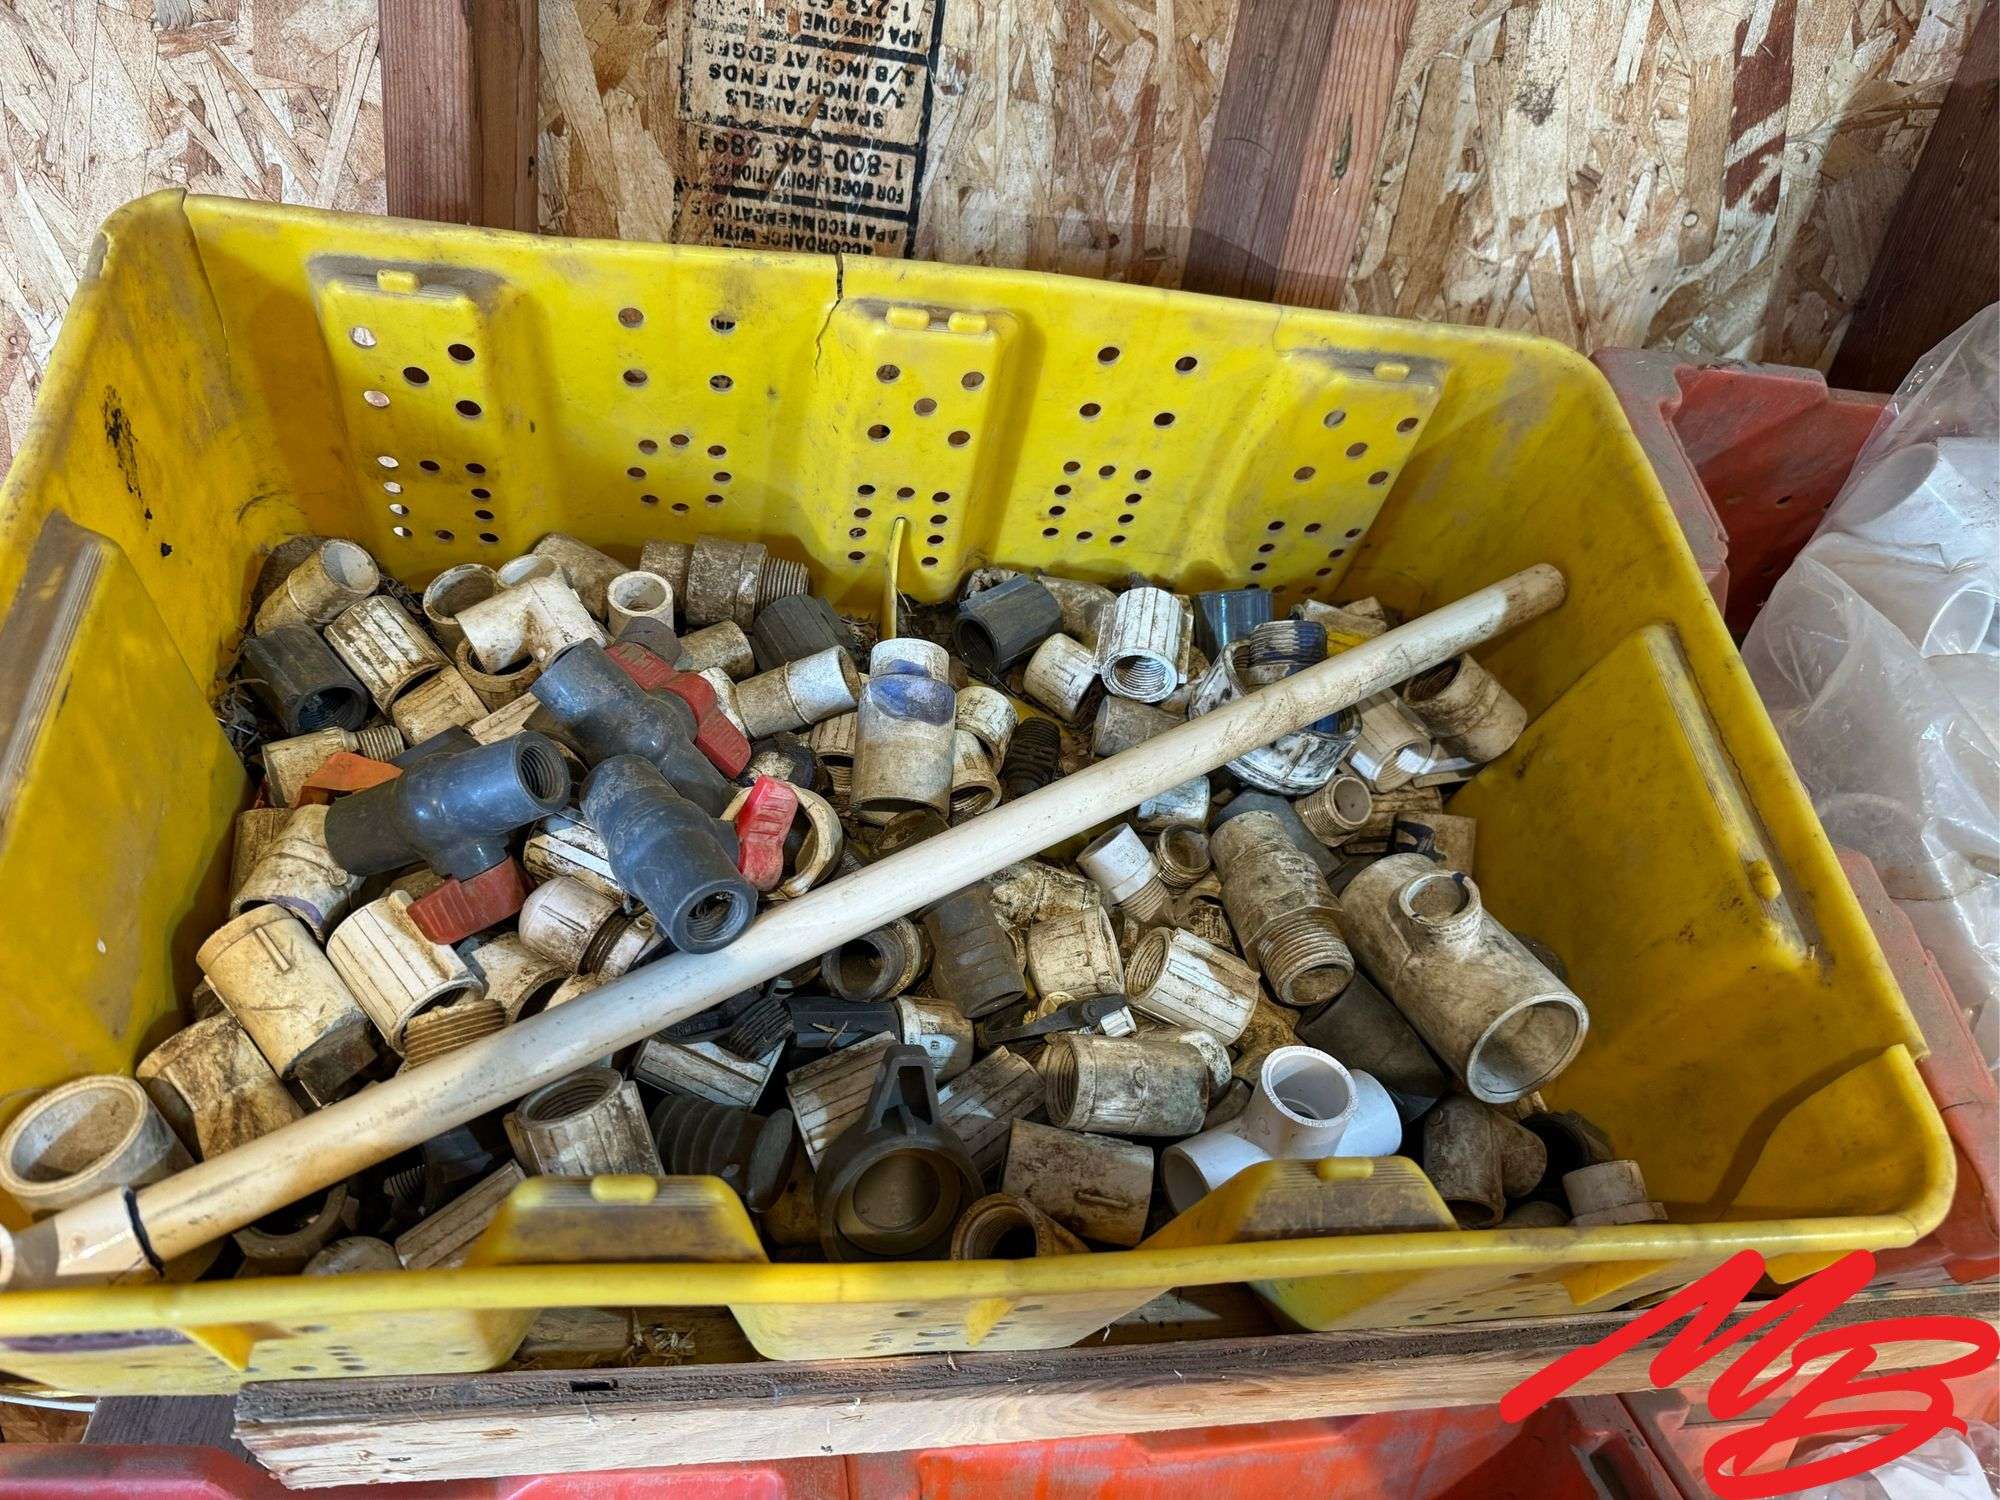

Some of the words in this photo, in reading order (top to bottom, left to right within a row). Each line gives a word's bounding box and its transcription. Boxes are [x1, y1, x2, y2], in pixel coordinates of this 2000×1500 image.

[800, 11, 885, 41] CUSTOME
[886, 24, 923, 49] APA
[783, 50, 810, 69] AT
[816, 55, 869, 79] INCH
[709, 63, 769, 89] ENDS
[774, 73, 801, 91] AT
[875, 65, 916, 88] 1/8
[725, 88, 810, 116] PANELS
[807, 77, 860, 104] INCH
[817, 102, 884, 129] SPACE
[877, 185, 904, 204] FOR
[713, 224, 756, 245] WITH
[866, 224, 899, 243] APA
